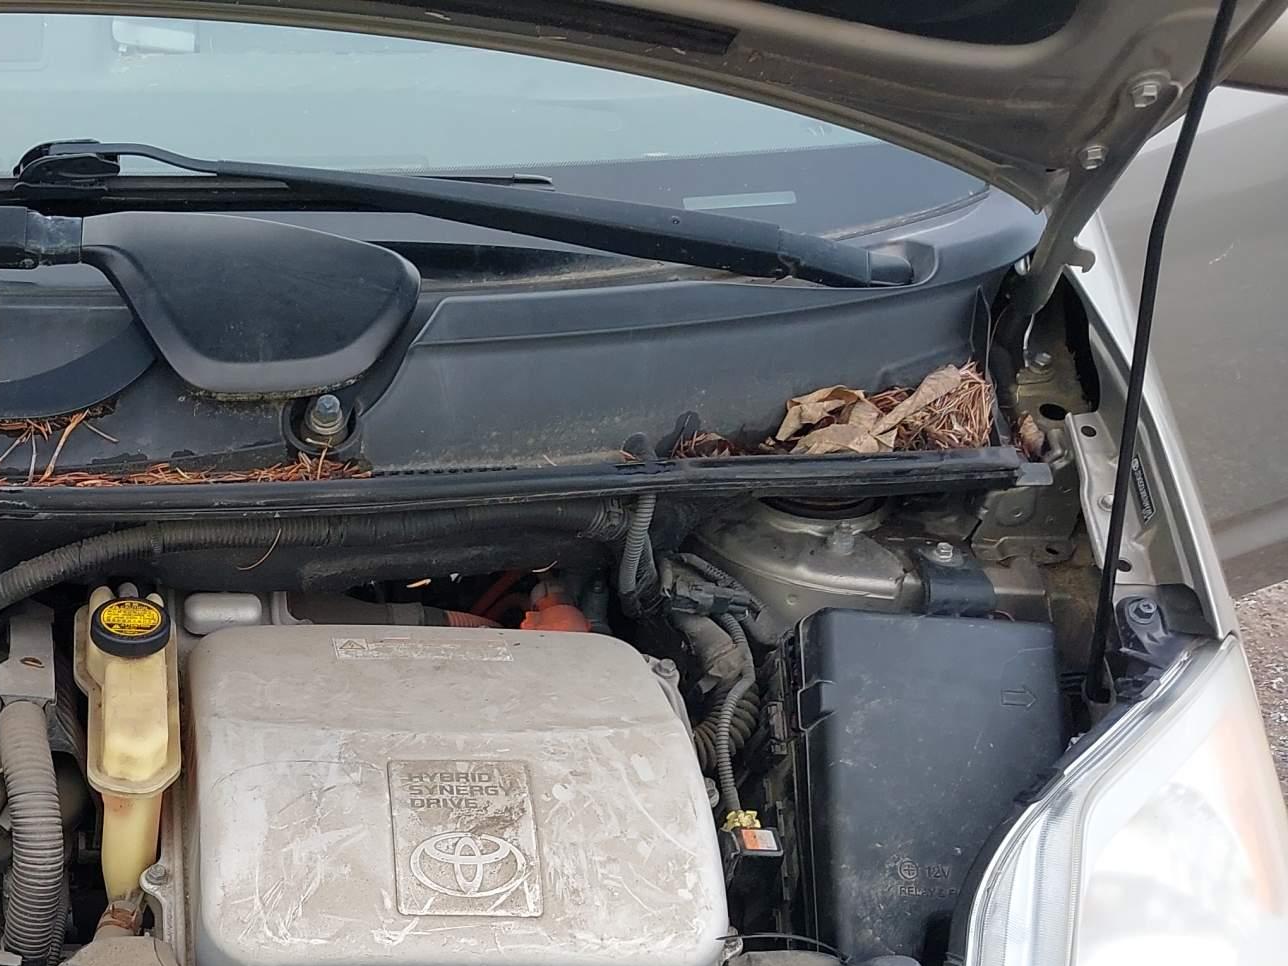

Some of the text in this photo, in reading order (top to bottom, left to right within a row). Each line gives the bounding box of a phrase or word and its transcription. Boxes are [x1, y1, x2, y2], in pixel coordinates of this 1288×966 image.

[407, 772, 492, 783] HYBRID
[409, 785, 512, 796] SYNERGY
[410, 798, 478, 809] DRIVE
[925, 864, 951, 879] 12V
